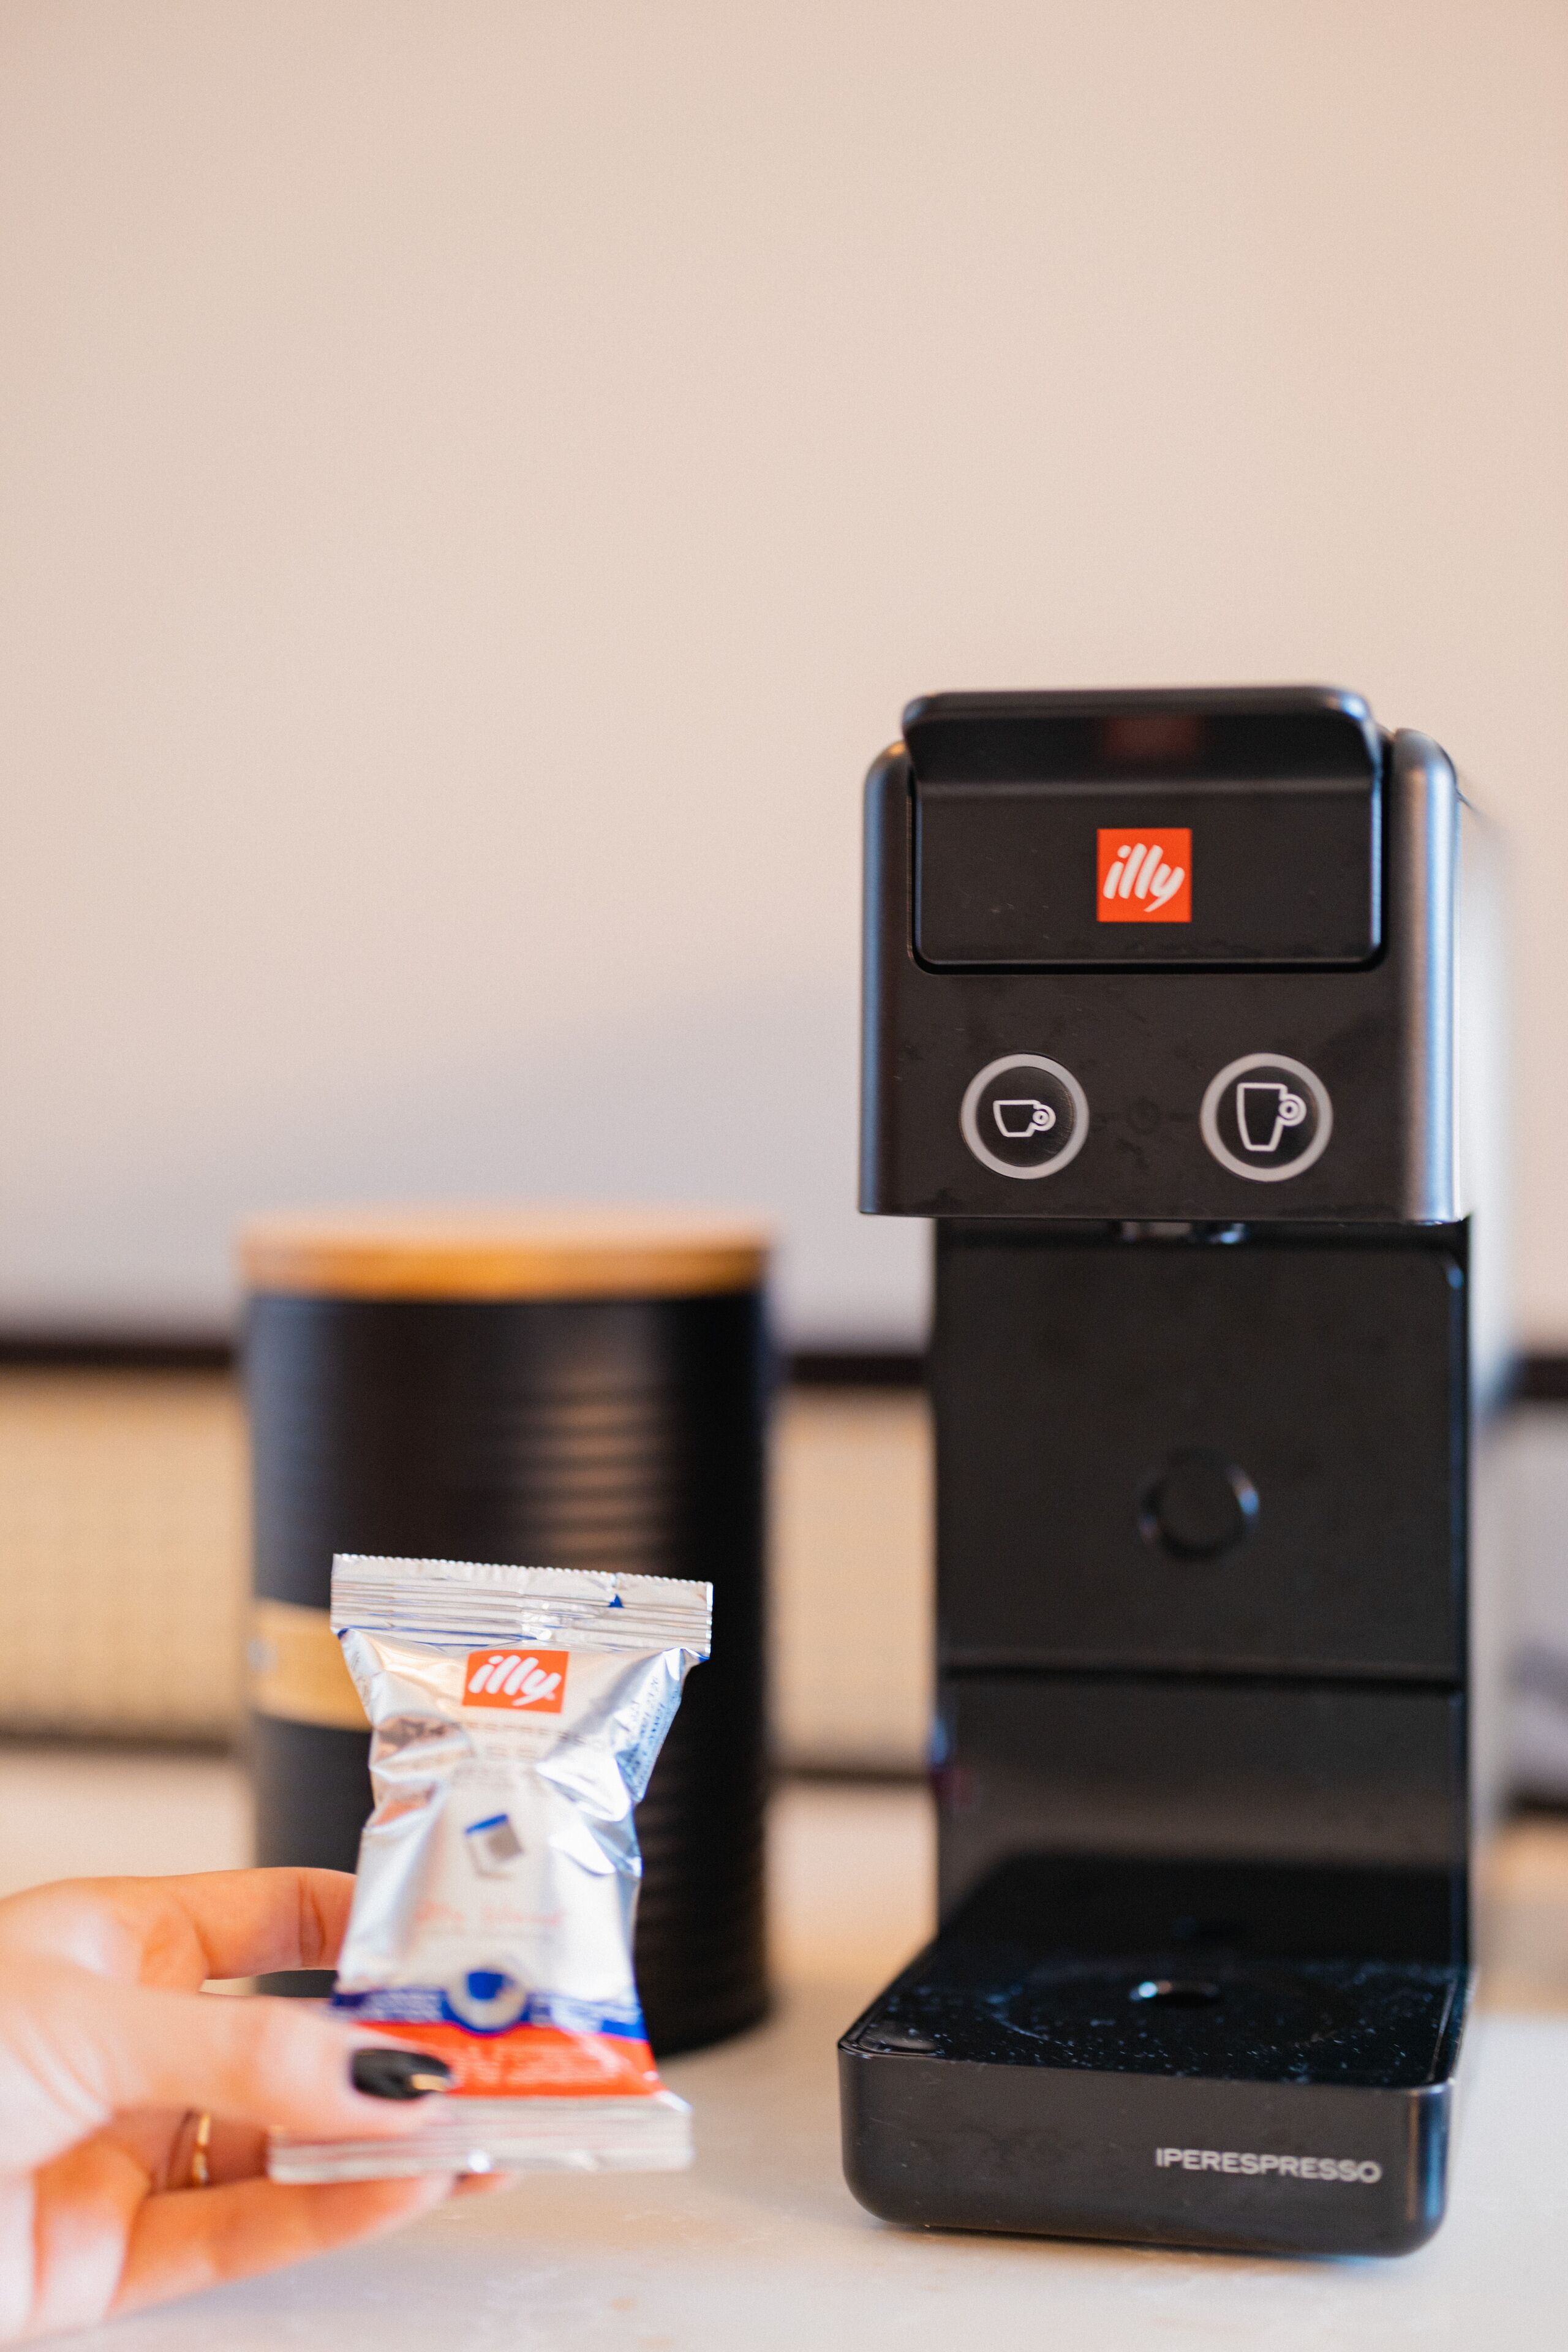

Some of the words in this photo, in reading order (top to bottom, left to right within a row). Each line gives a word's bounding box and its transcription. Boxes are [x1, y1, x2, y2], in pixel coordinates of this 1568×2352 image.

[1103, 842, 1186, 913] illy
[468, 1654, 562, 1706] illy
[1155, 2147, 1382, 2184] IPERESPRESSO
